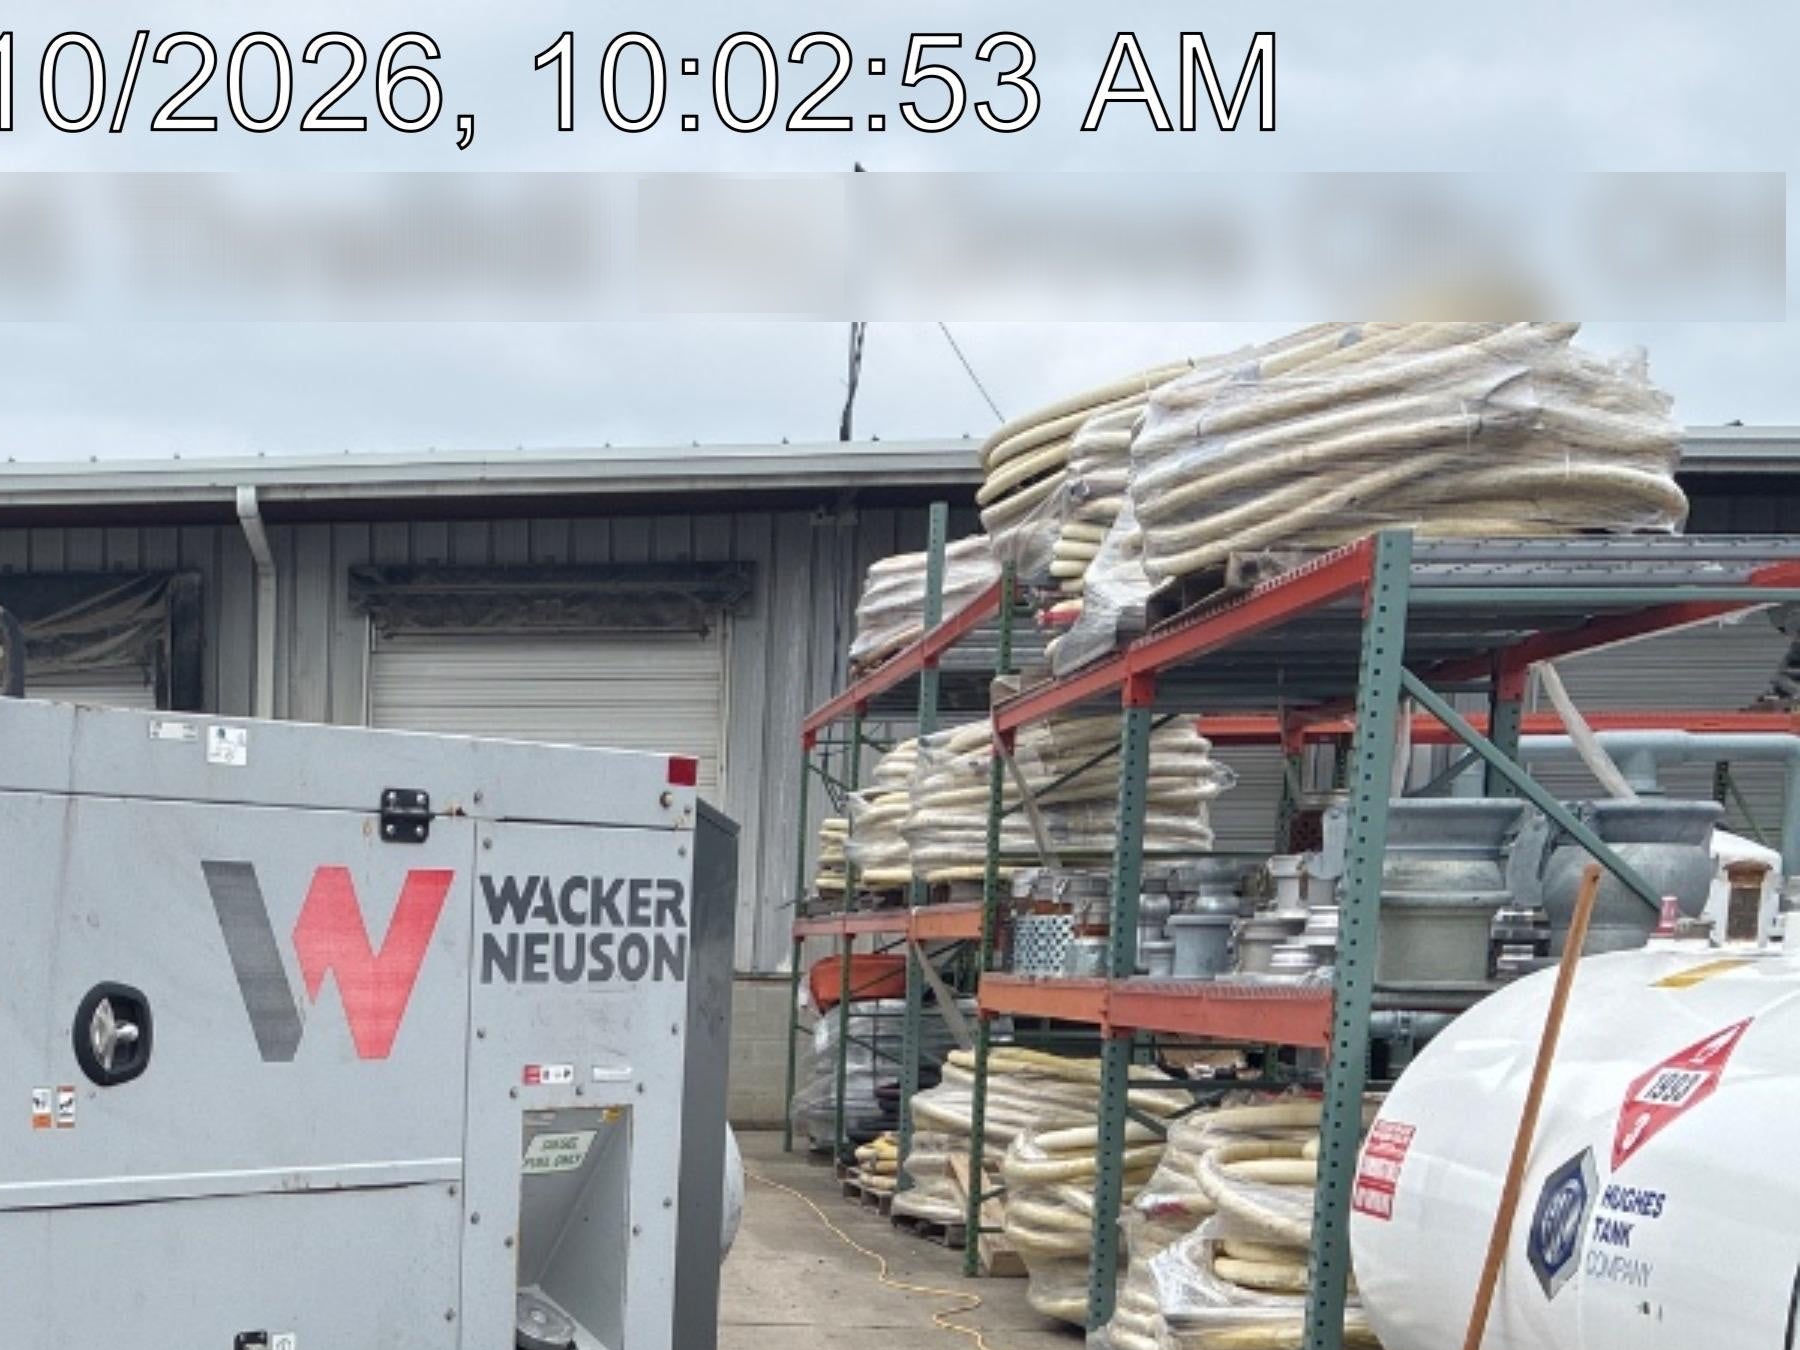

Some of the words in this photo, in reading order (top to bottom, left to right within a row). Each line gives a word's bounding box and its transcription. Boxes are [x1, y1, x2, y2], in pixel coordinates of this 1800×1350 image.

[479, 875, 688, 928] WACKER
[479, 932, 688, 984] NEUSON
[1600, 1184, 1666, 1218] HUGHES
[1593, 1215, 1635, 1248] TANK
[1586, 1250, 1654, 1287] COMPANY
